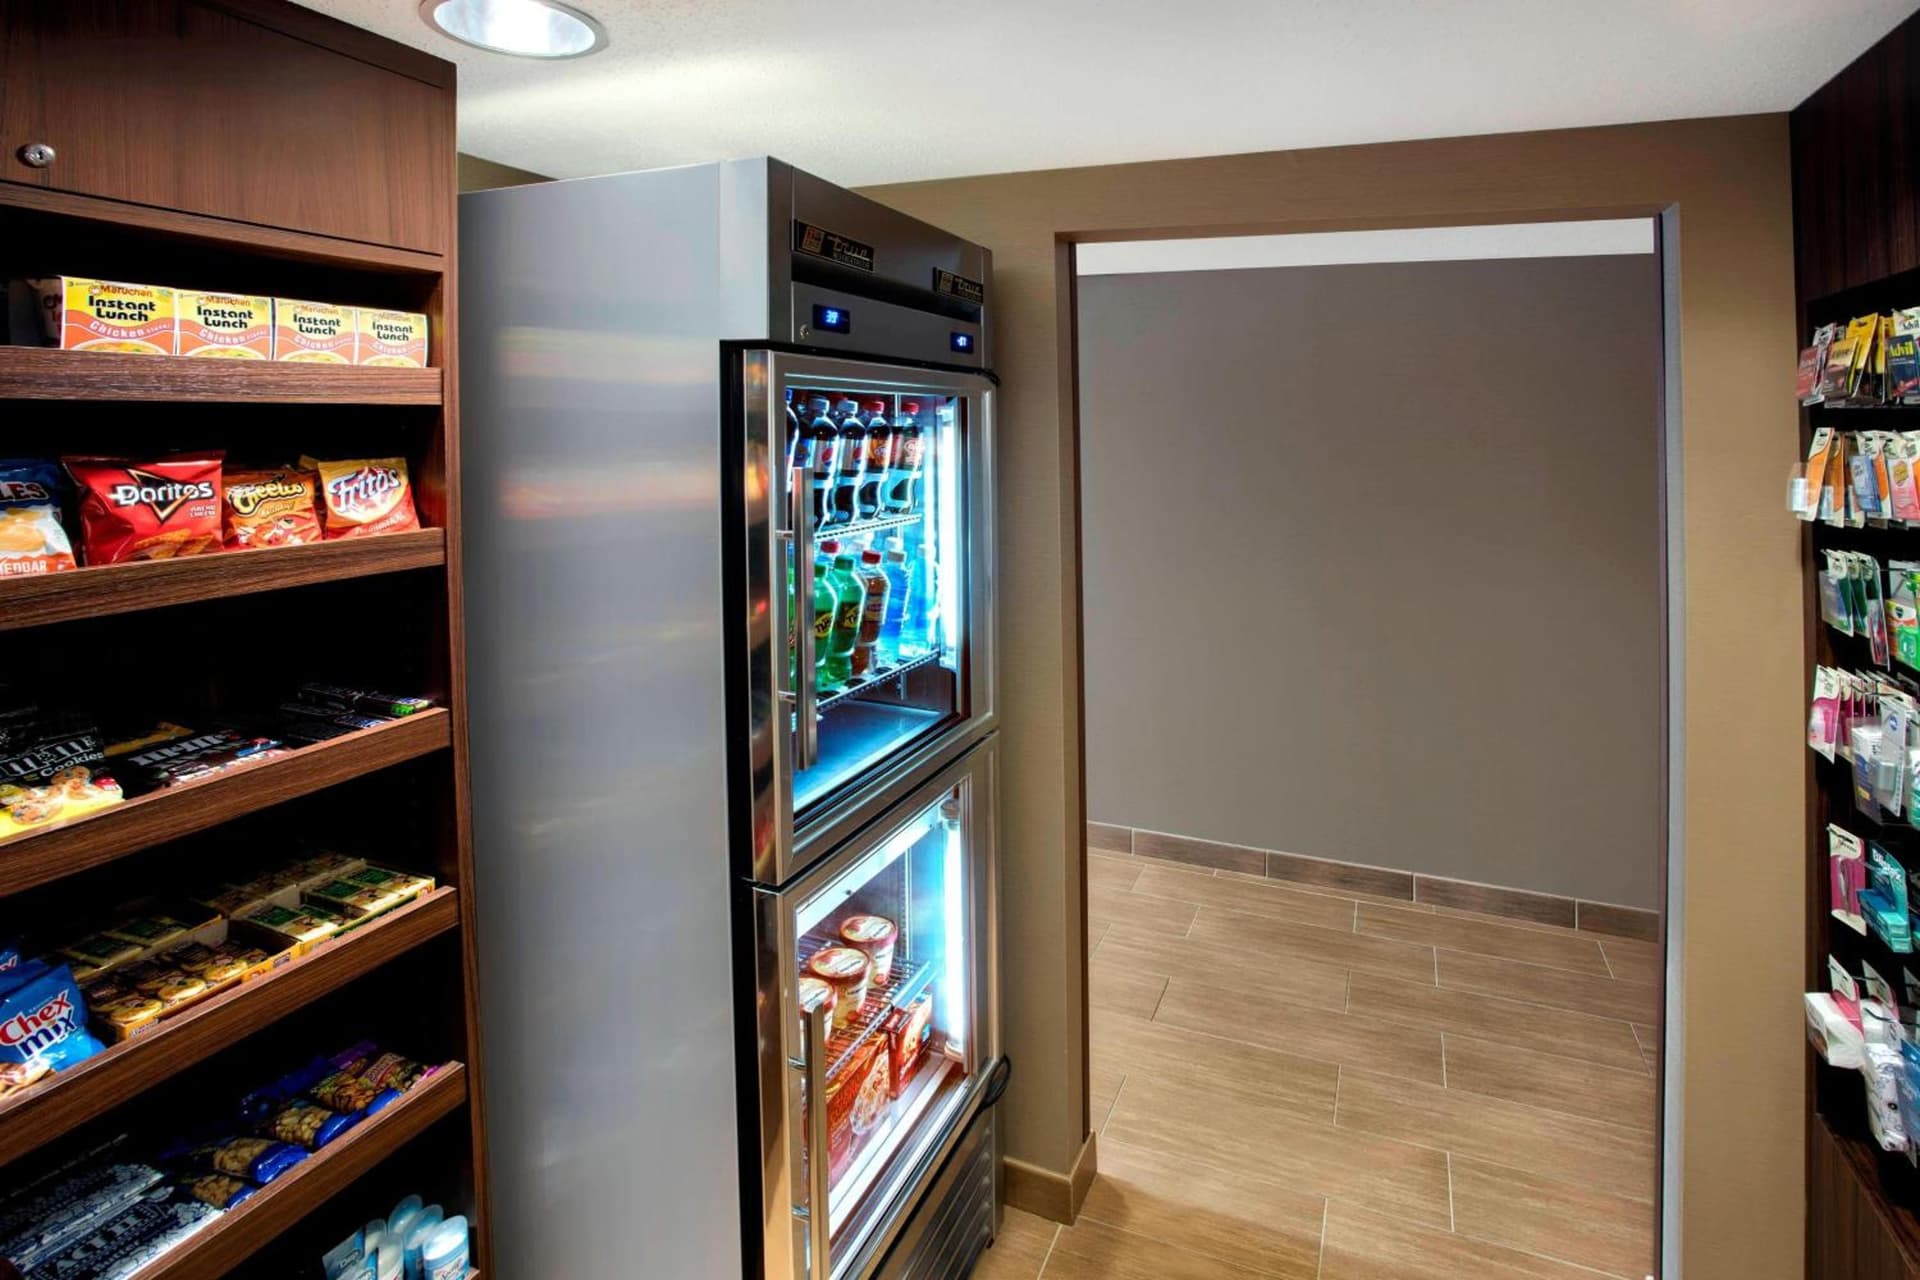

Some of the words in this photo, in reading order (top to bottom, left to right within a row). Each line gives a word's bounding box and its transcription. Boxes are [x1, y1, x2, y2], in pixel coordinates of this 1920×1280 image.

[88, 295, 156, 311] Instant
[96, 308, 149, 322] Lunch
[197, 305, 254, 319] Instant
[204, 317, 248, 328] Lunch
[293, 313, 341, 327] Instant
[372, 321, 414, 333] Instant
[90, 321, 145, 337] Chicken
[299, 324, 336, 335] Lunch
[377, 331, 409, 341] Lunch
[114, 481, 214, 506] Doritos
[328, 468, 401, 513] Fritos
[40, 751, 104, 777] Cookies
[0, 990, 71, 1044] Chex
